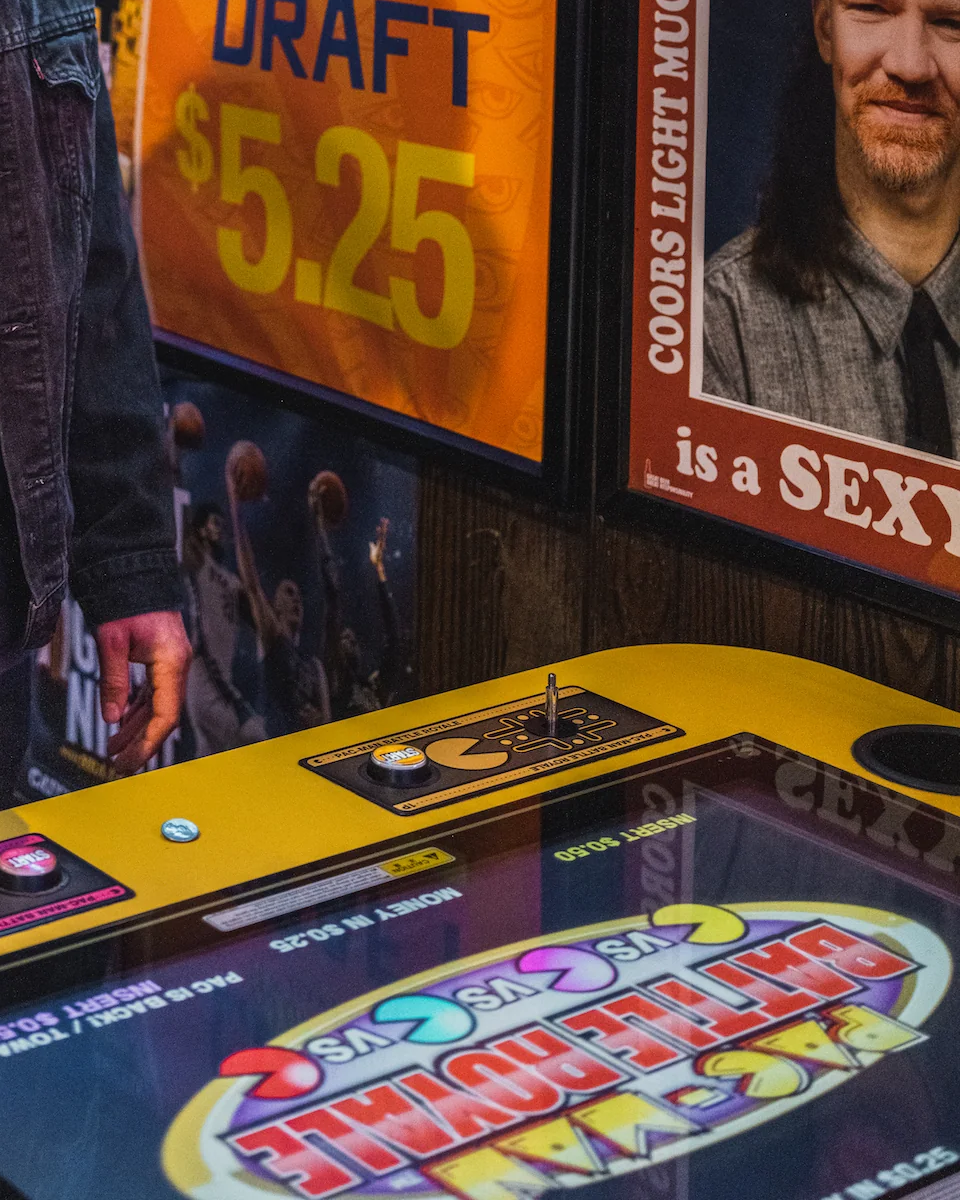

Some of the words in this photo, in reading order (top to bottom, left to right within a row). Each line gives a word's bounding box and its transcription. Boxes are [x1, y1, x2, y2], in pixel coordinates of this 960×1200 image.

[651, 87, 689, 223] LIGHT
[174, 82, 476, 350] $5.25
[648, 228, 686, 376] COORS
[676, 426, 718, 482] is
[731, 455, 761, 496] a
[335, 739, 383, 760] PAC-MAN
[382, 729, 422, 748] BATTLE
[421, 719, 462, 739] ROYALE
[382, 746, 421, 765] START
[570, 741, 610, 760] BATTLE
[610, 731, 653, 749] PAC-MAN
[531, 751, 570, 773] ROYALE
[619, 812, 698, 843] INSERT
[7, 847, 54, 867] START
[553, 835, 622, 863] $0.50
[375, 887, 463, 921] MONEY
[269, 923, 346, 953] $0.25
[341, 913, 376, 931] IN
[593, 930, 676, 961] VS
[61, 978, 163, 1019] INSERT
[164, 987, 196, 1003] IS
[191, 971, 244, 994] PAC
[453, 976, 540, 1012] VS
[558, 921, 920, 1072] BATTLE
[86, 994, 169, 1028] BACK!
[305, 1026, 393, 1064] VS
[228, 1027, 626, 1198] ROYALE
